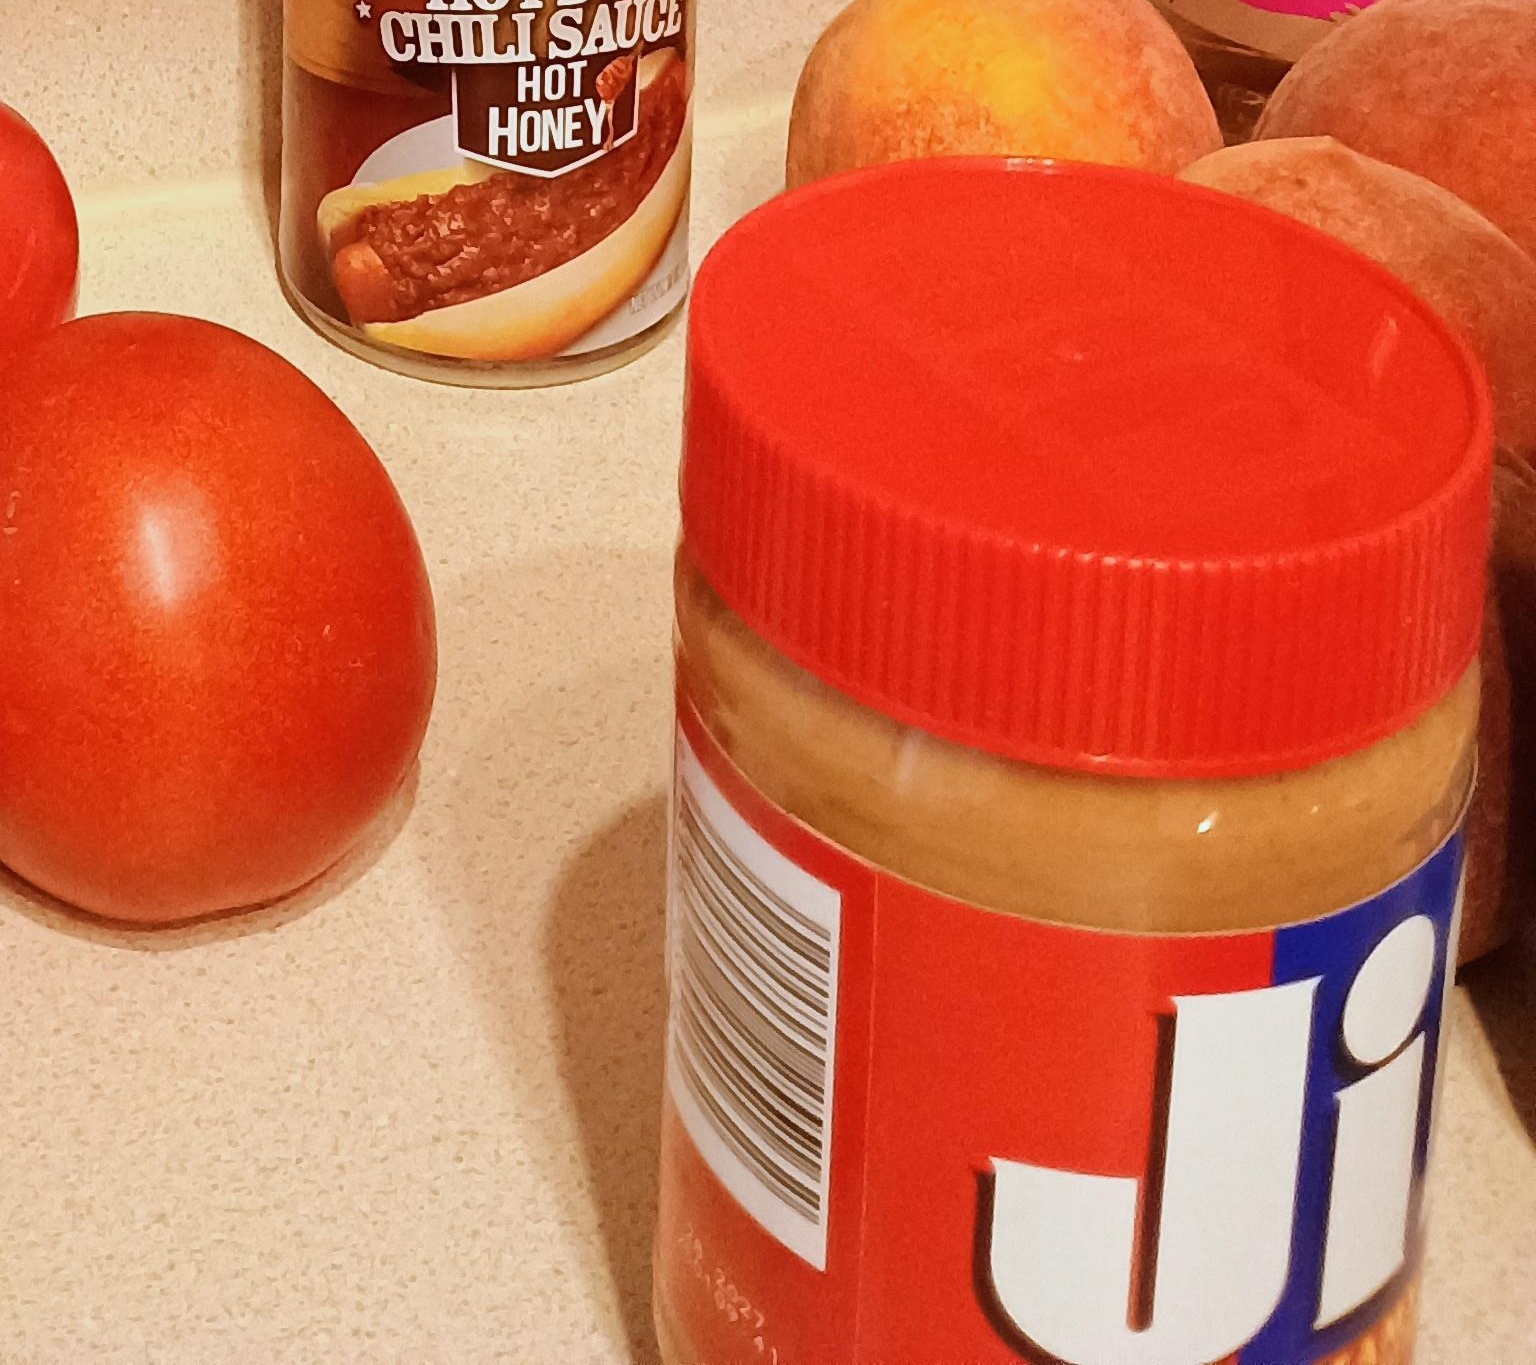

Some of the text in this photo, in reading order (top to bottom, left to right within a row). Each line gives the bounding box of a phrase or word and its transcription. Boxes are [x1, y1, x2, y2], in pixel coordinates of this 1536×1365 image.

[379, 10, 536, 65] CHILI
[516, 60, 588, 102] HOT
[487, 96, 609, 157] HONEY
[972, 911, 1436, 1365] Ji
